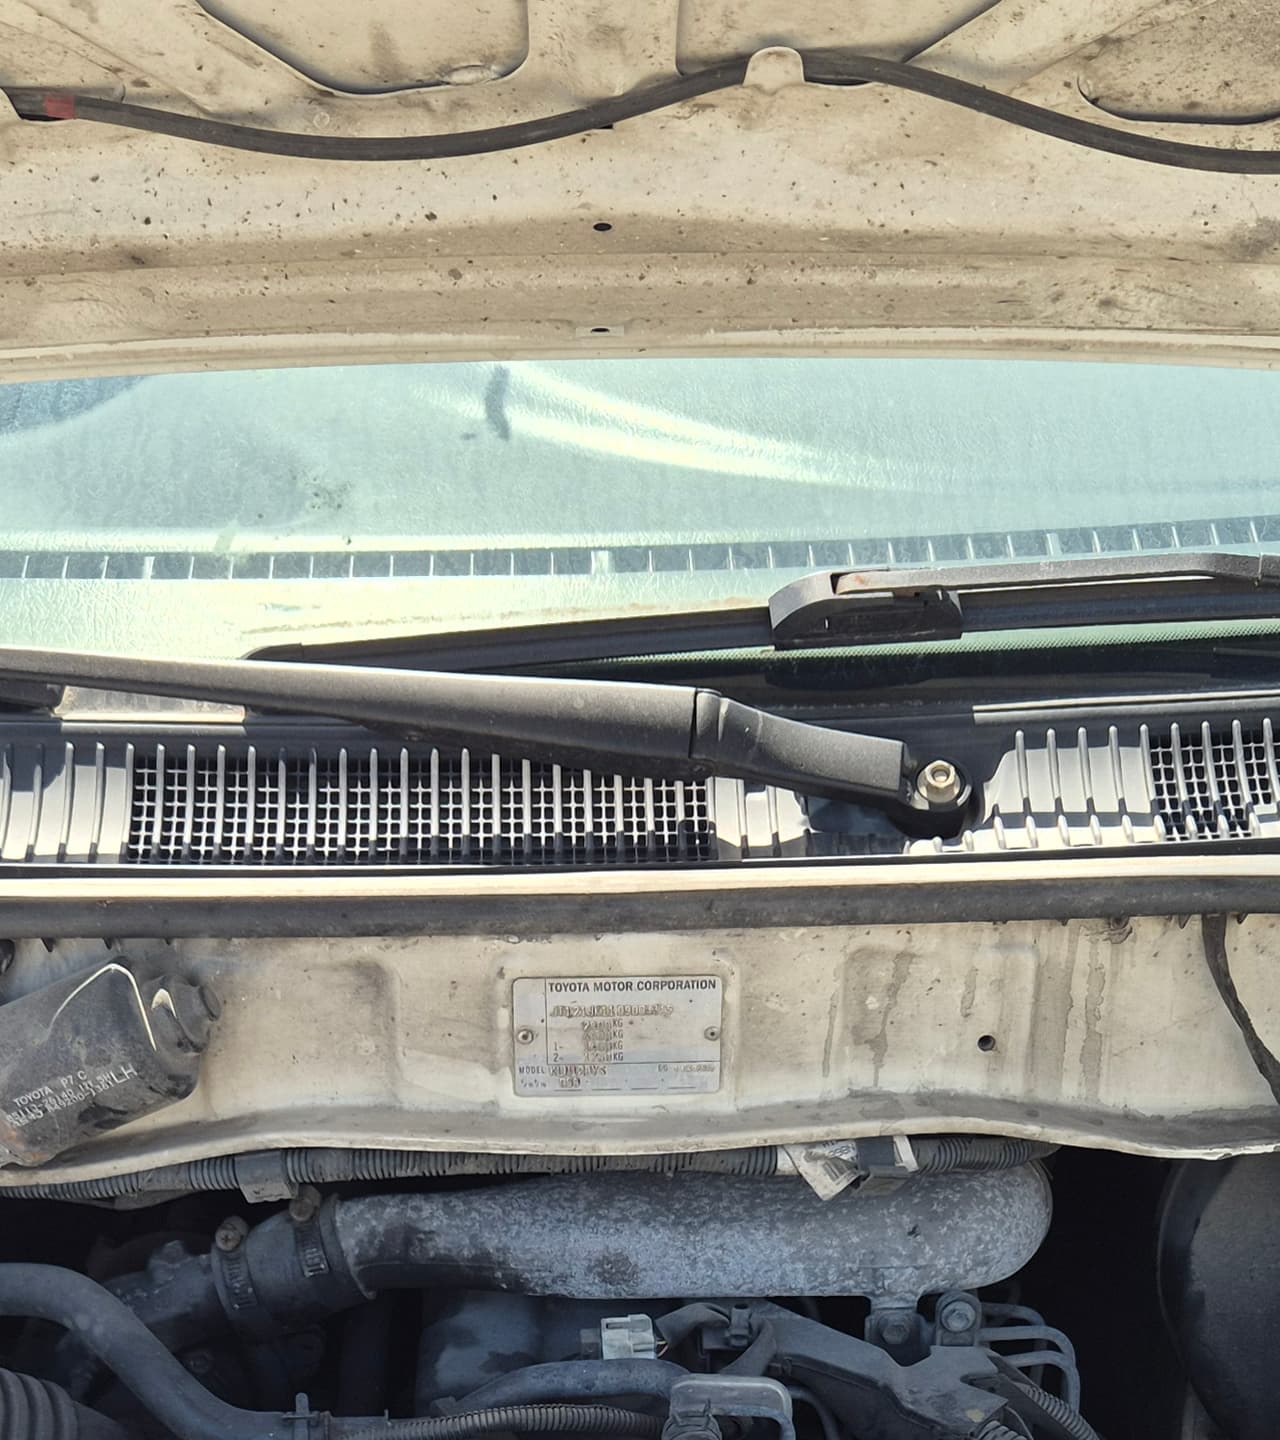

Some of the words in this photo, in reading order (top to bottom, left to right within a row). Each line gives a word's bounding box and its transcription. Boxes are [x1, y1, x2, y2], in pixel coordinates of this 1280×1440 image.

[548, 982, 590, 993] TOYOTA
[593, 981, 633, 992] MOTOR
[636, 979, 717, 991] CORPORATION
[613, 1051, 624, 1061] KG
[110, 1063, 138, 1084] LH
[13, 1086, 54, 1107] TOYOTA
